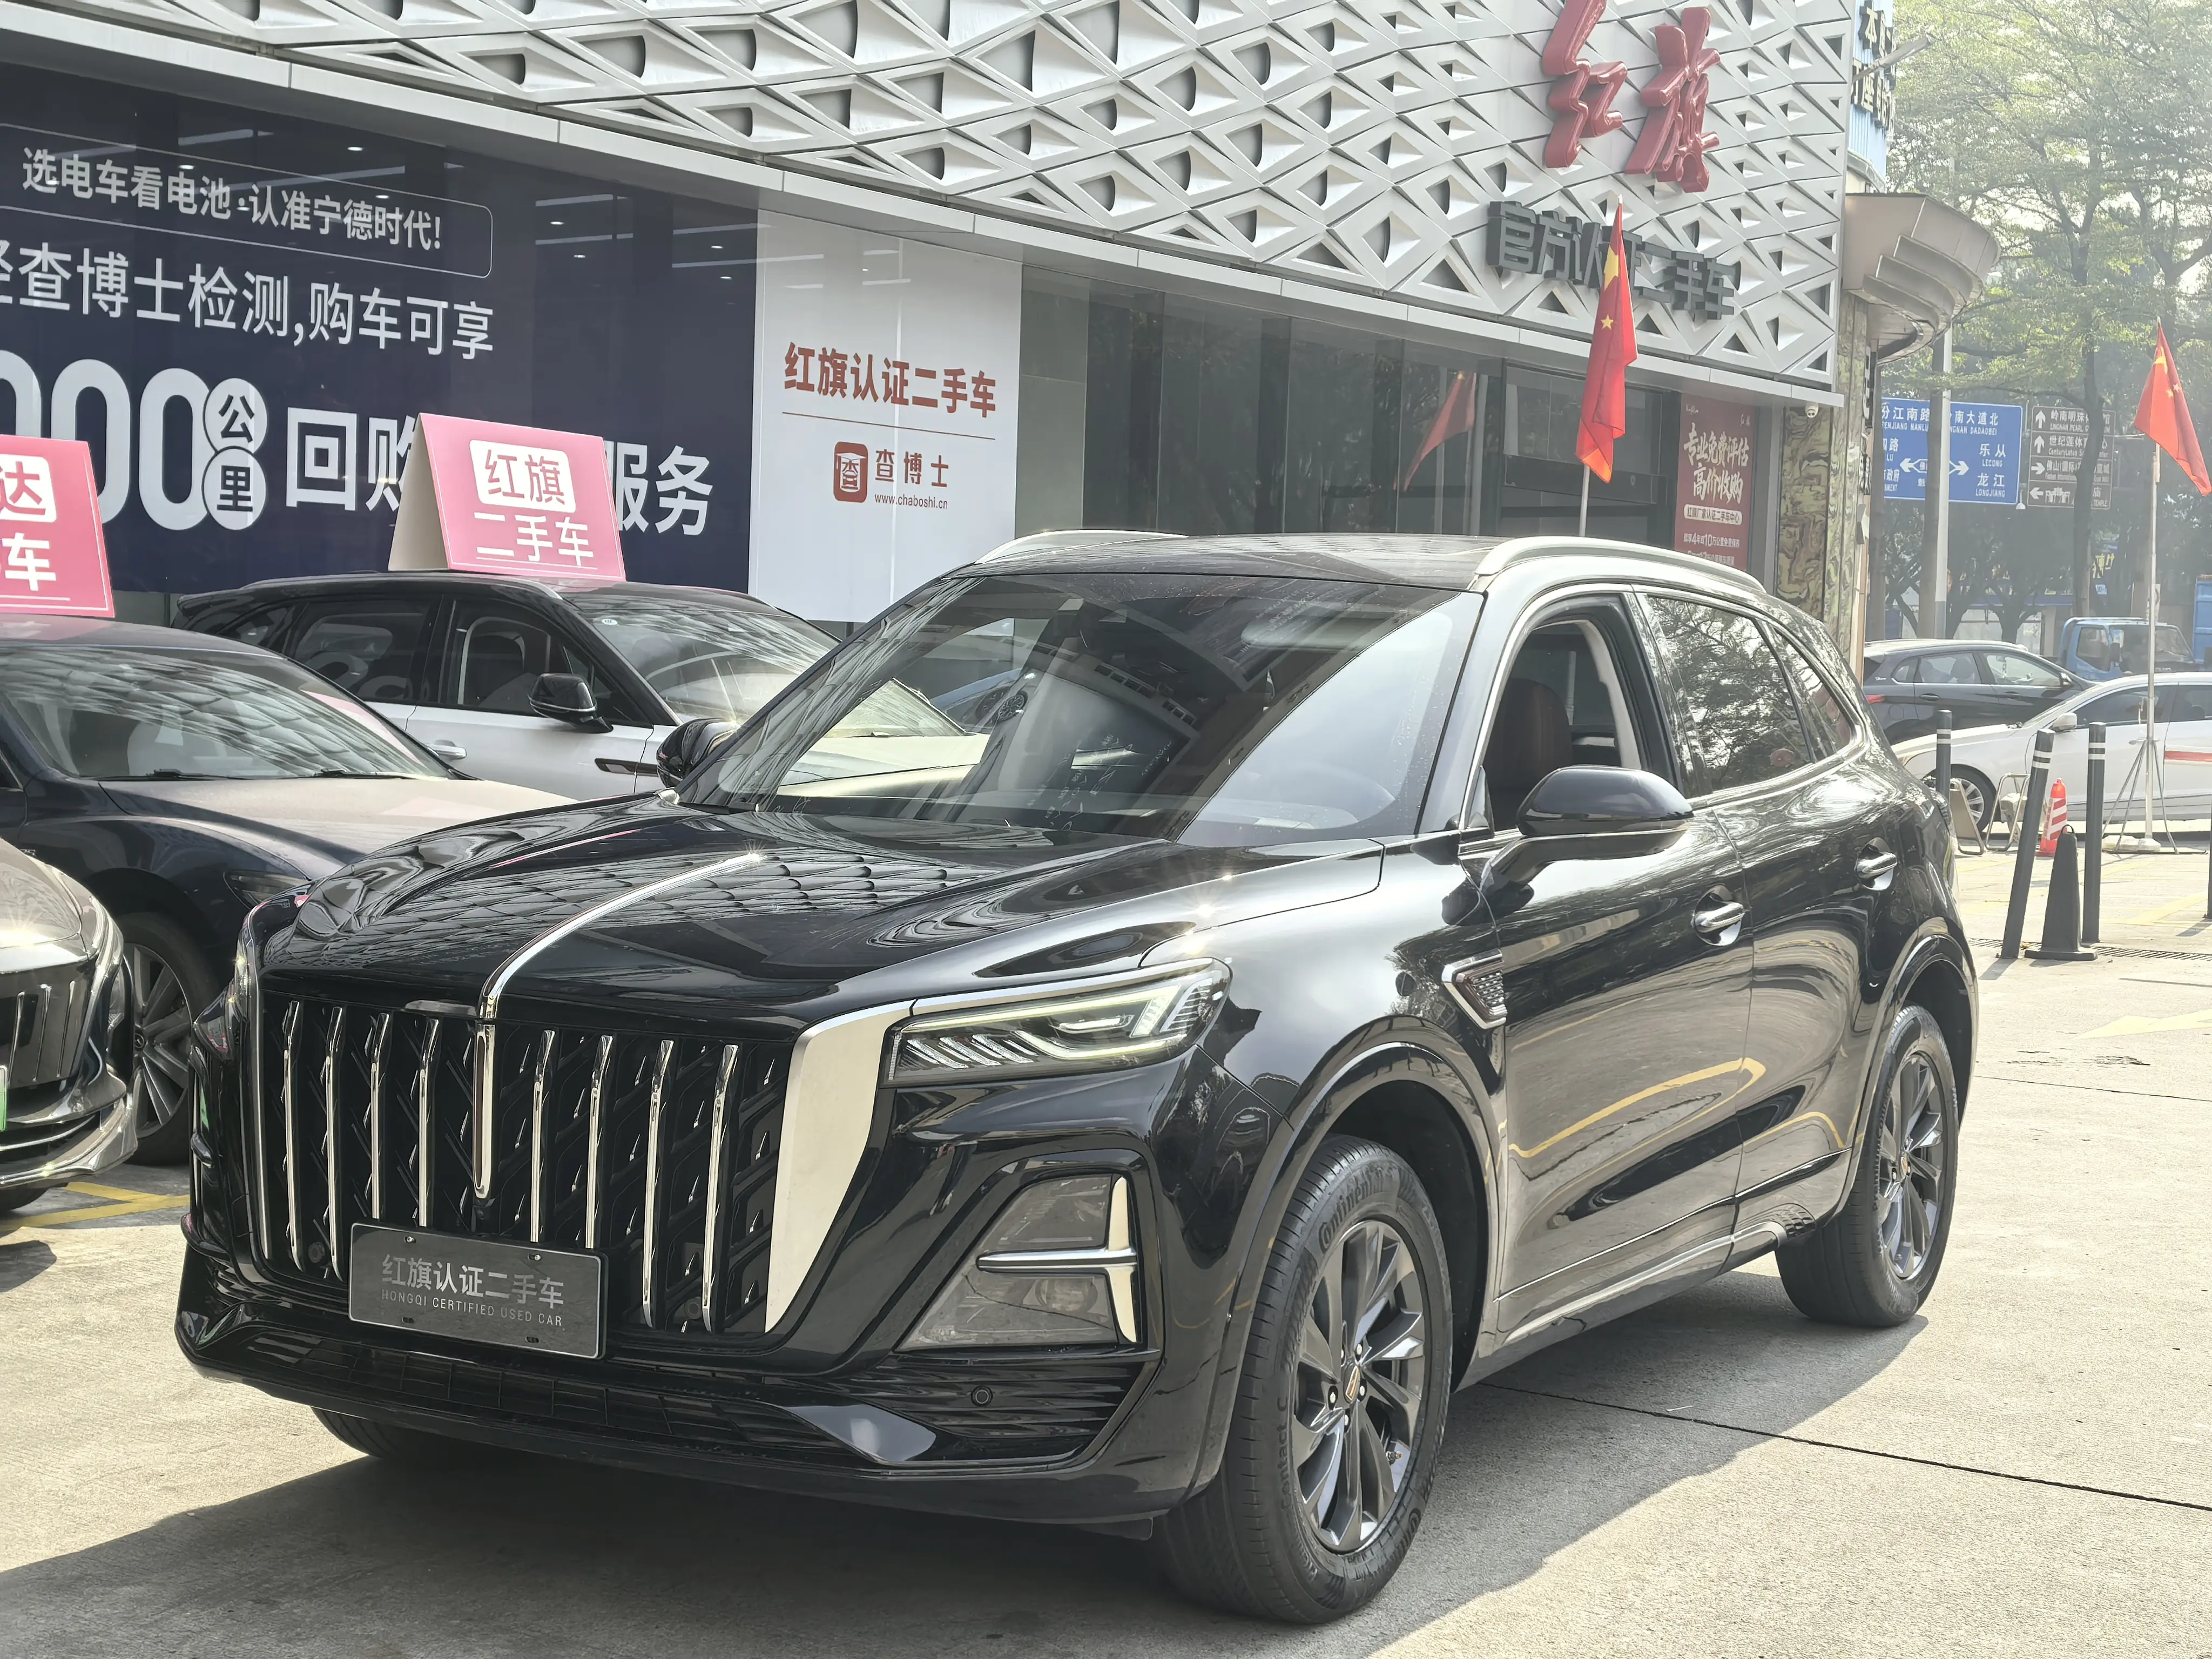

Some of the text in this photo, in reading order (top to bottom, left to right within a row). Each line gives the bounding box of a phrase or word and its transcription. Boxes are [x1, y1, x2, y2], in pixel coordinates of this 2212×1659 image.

[0, 240, 494, 360] 查博士检测,购车可享
[784, 342, 996, 418] 红旗认证二手车
[1911, 423, 1929, 432] NANLU
[1950, 409, 1998, 426] 南大道北
[1683, 422, 1749, 469] 专业免费评估
[1979, 443, 2006, 458] 乐从
[1982, 459, 2002, 468] LECONG
[485, 449, 565, 506] 红旗
[875, 449, 949, 488] 查博士
[1694, 462, 1744, 504] 高价收购
[1977, 473, 2005, 487] 龙江
[874, 493, 948, 510] www.chaboshi.cn
[1975, 489, 2006, 498] LONGJIANG
[474, 512, 595, 567] 二手车
[382, 1253, 564, 1310] 红旗认证二手车
[381, 1289, 562, 1327] HONGQI CERTIFIED USED CAR
